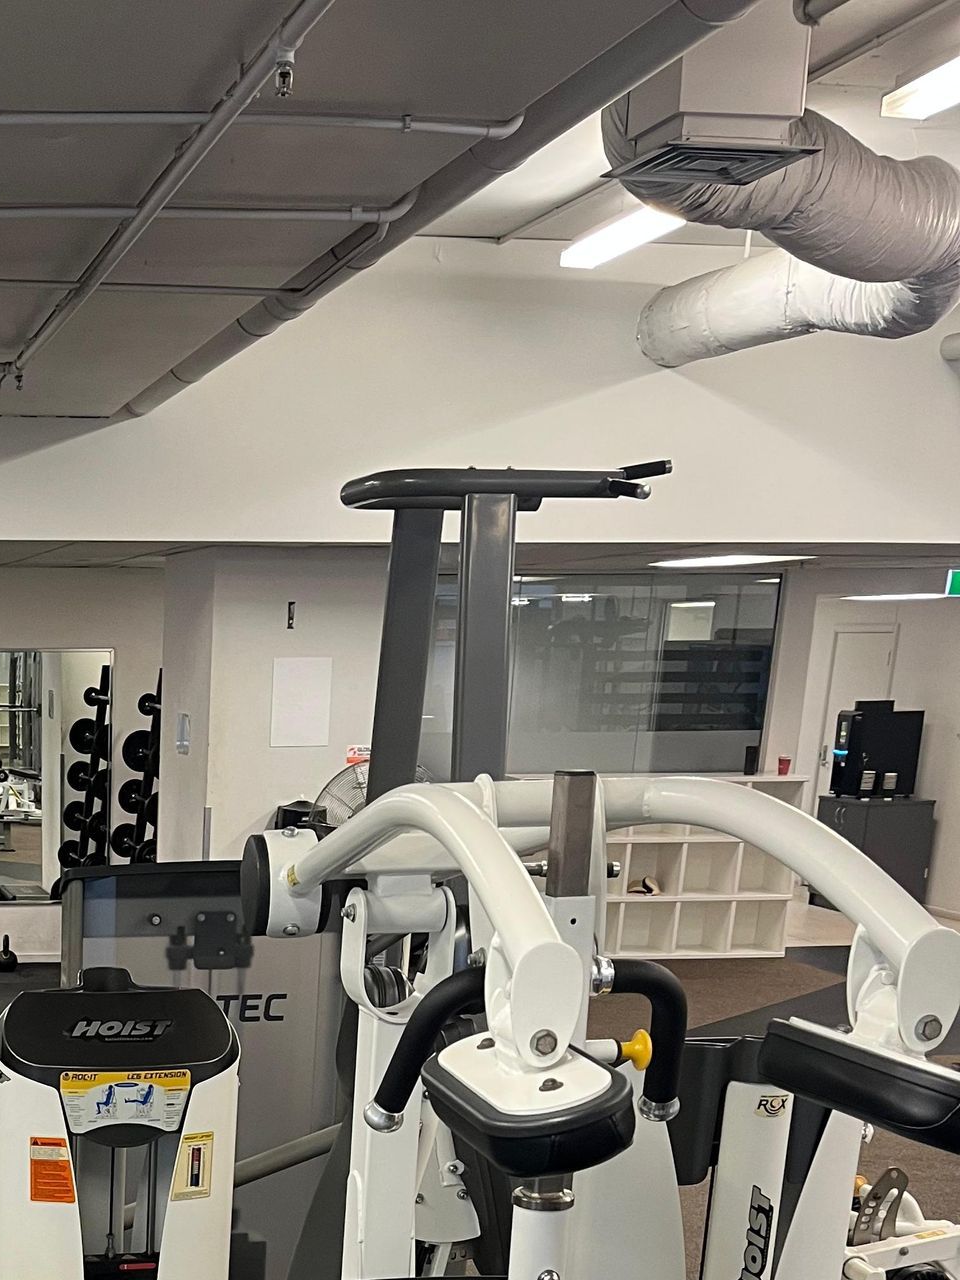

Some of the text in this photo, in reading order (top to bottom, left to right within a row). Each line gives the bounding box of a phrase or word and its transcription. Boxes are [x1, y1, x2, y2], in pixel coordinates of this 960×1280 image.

[216, 993, 288, 1022] TEC
[71, 1020, 172, 1037] HOIST
[143, 1071, 187, 1080] EXTENSION
